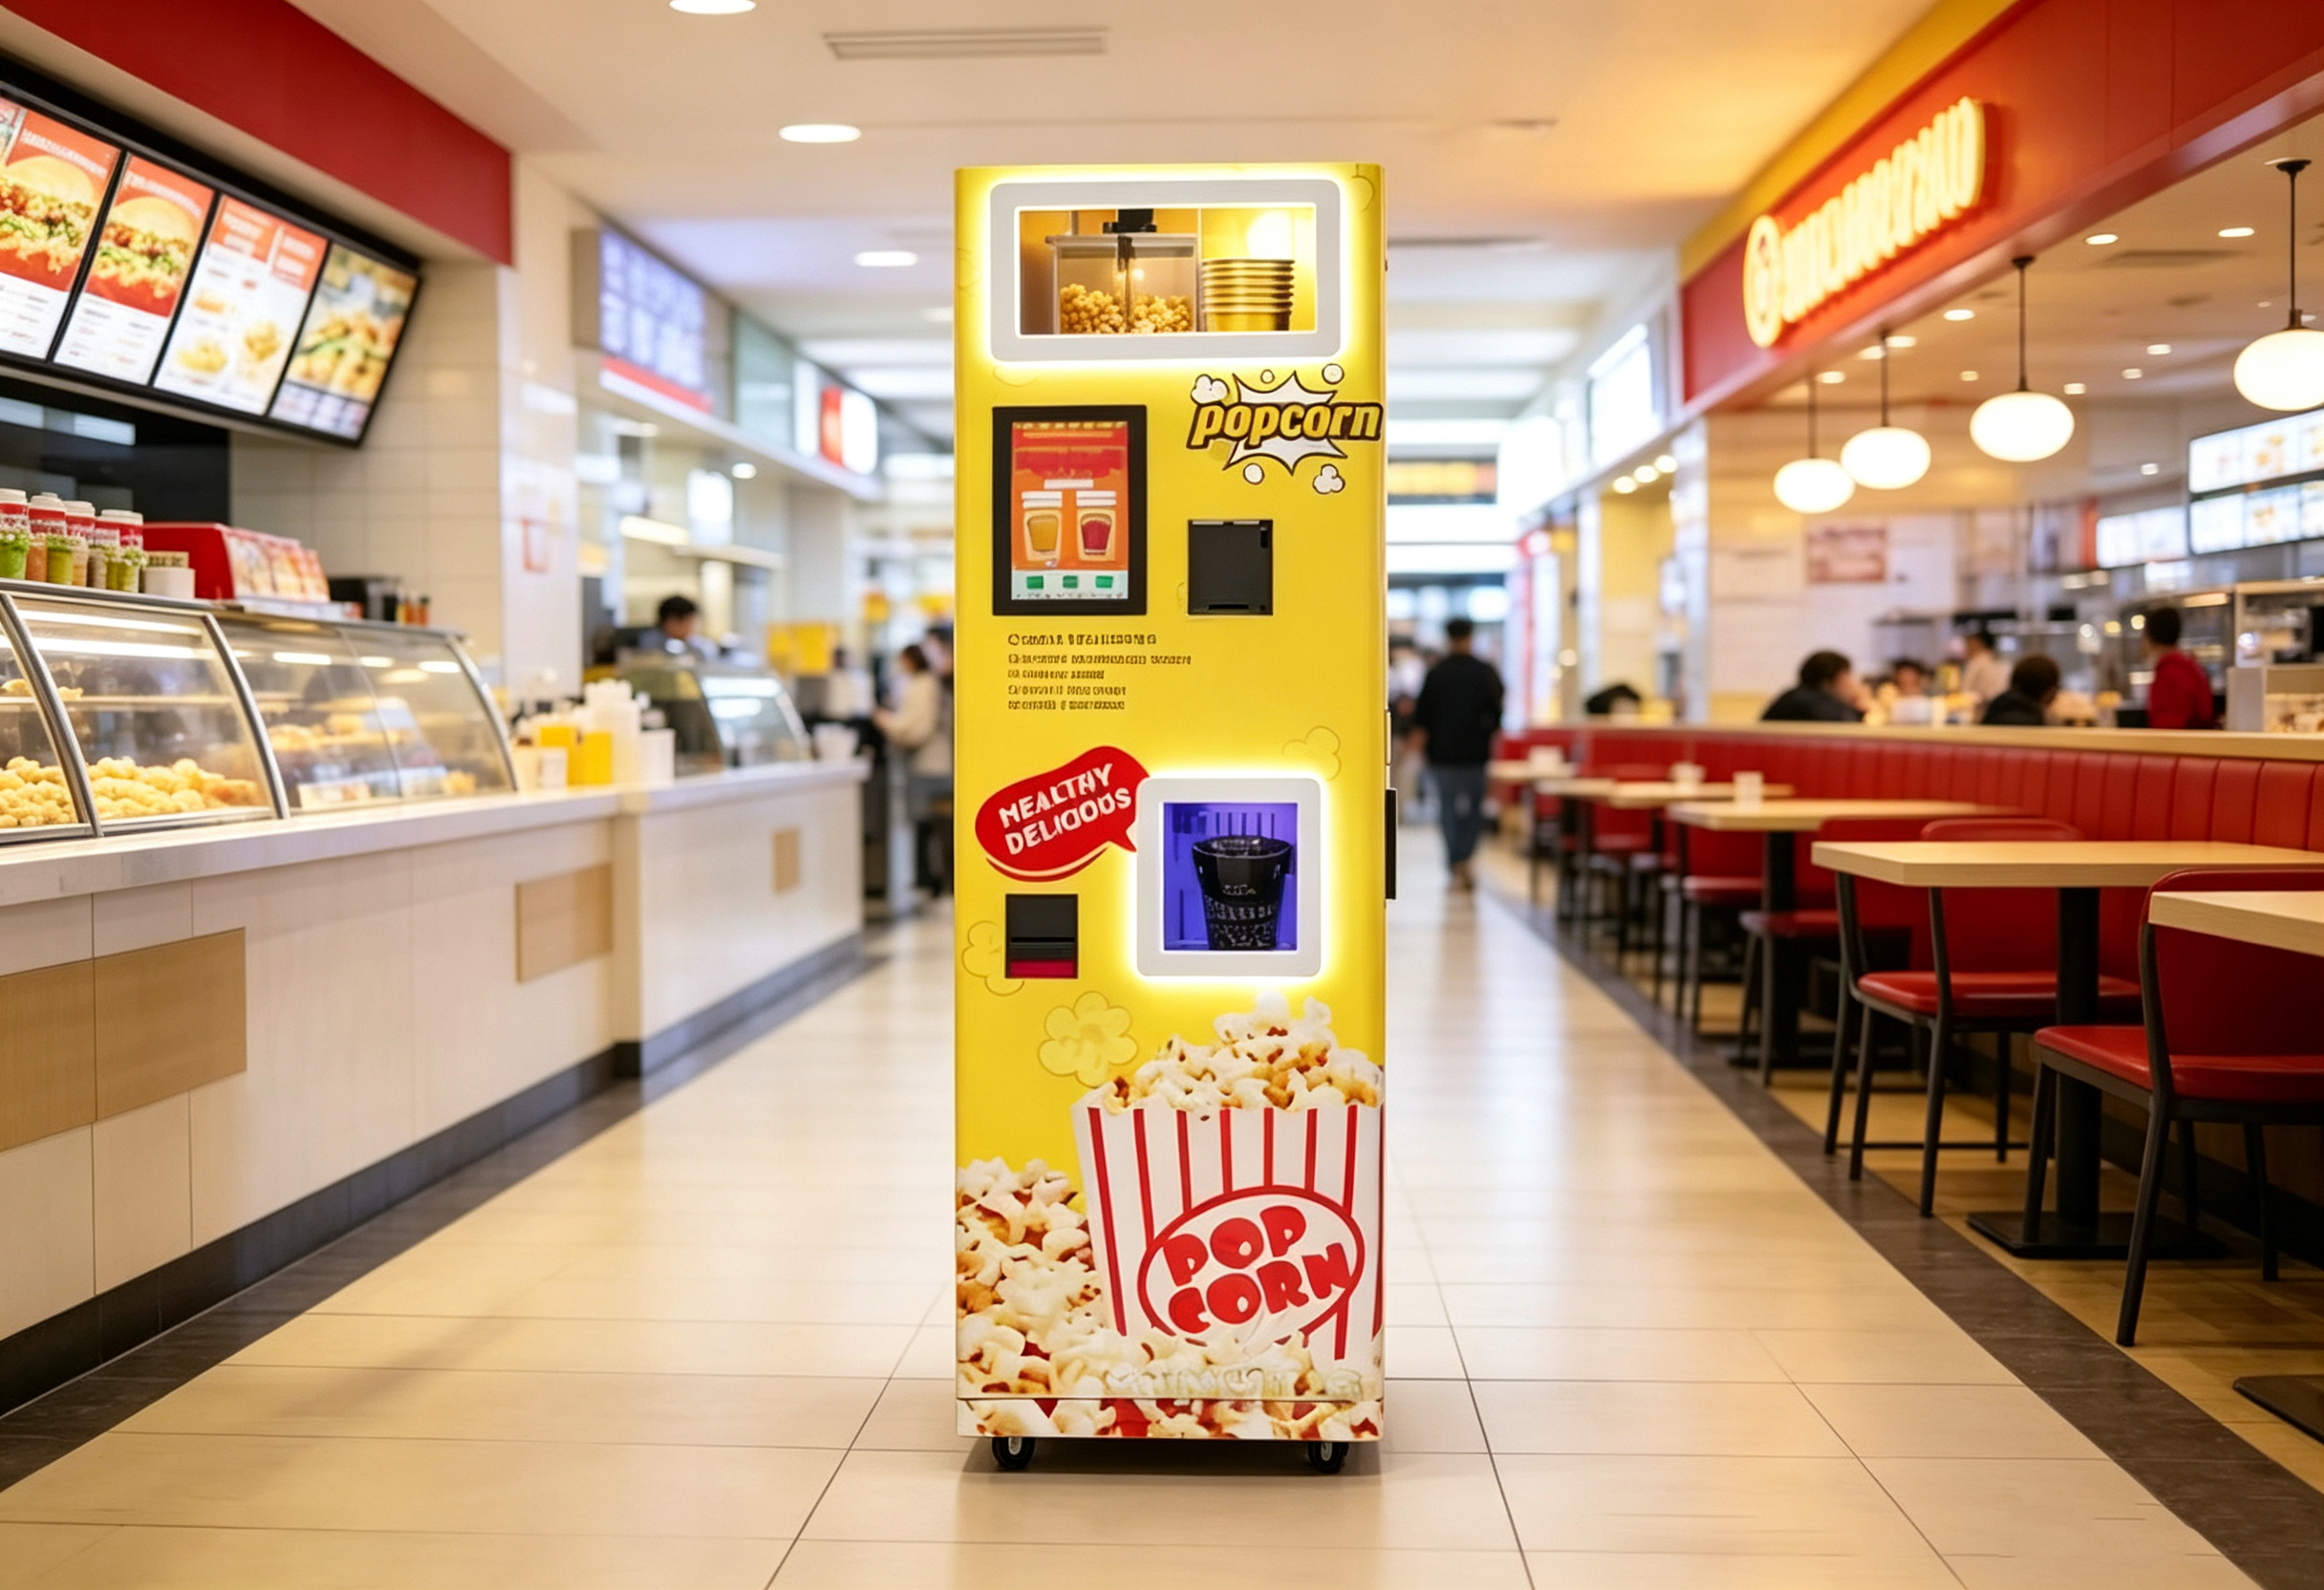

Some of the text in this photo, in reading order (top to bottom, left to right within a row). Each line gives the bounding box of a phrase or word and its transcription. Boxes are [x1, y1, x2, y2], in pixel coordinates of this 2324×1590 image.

[1187, 402, 1383, 449] popcorn
[1163, 1205, 1306, 1287] POP
[1168, 1242, 1351, 1334] CORN
